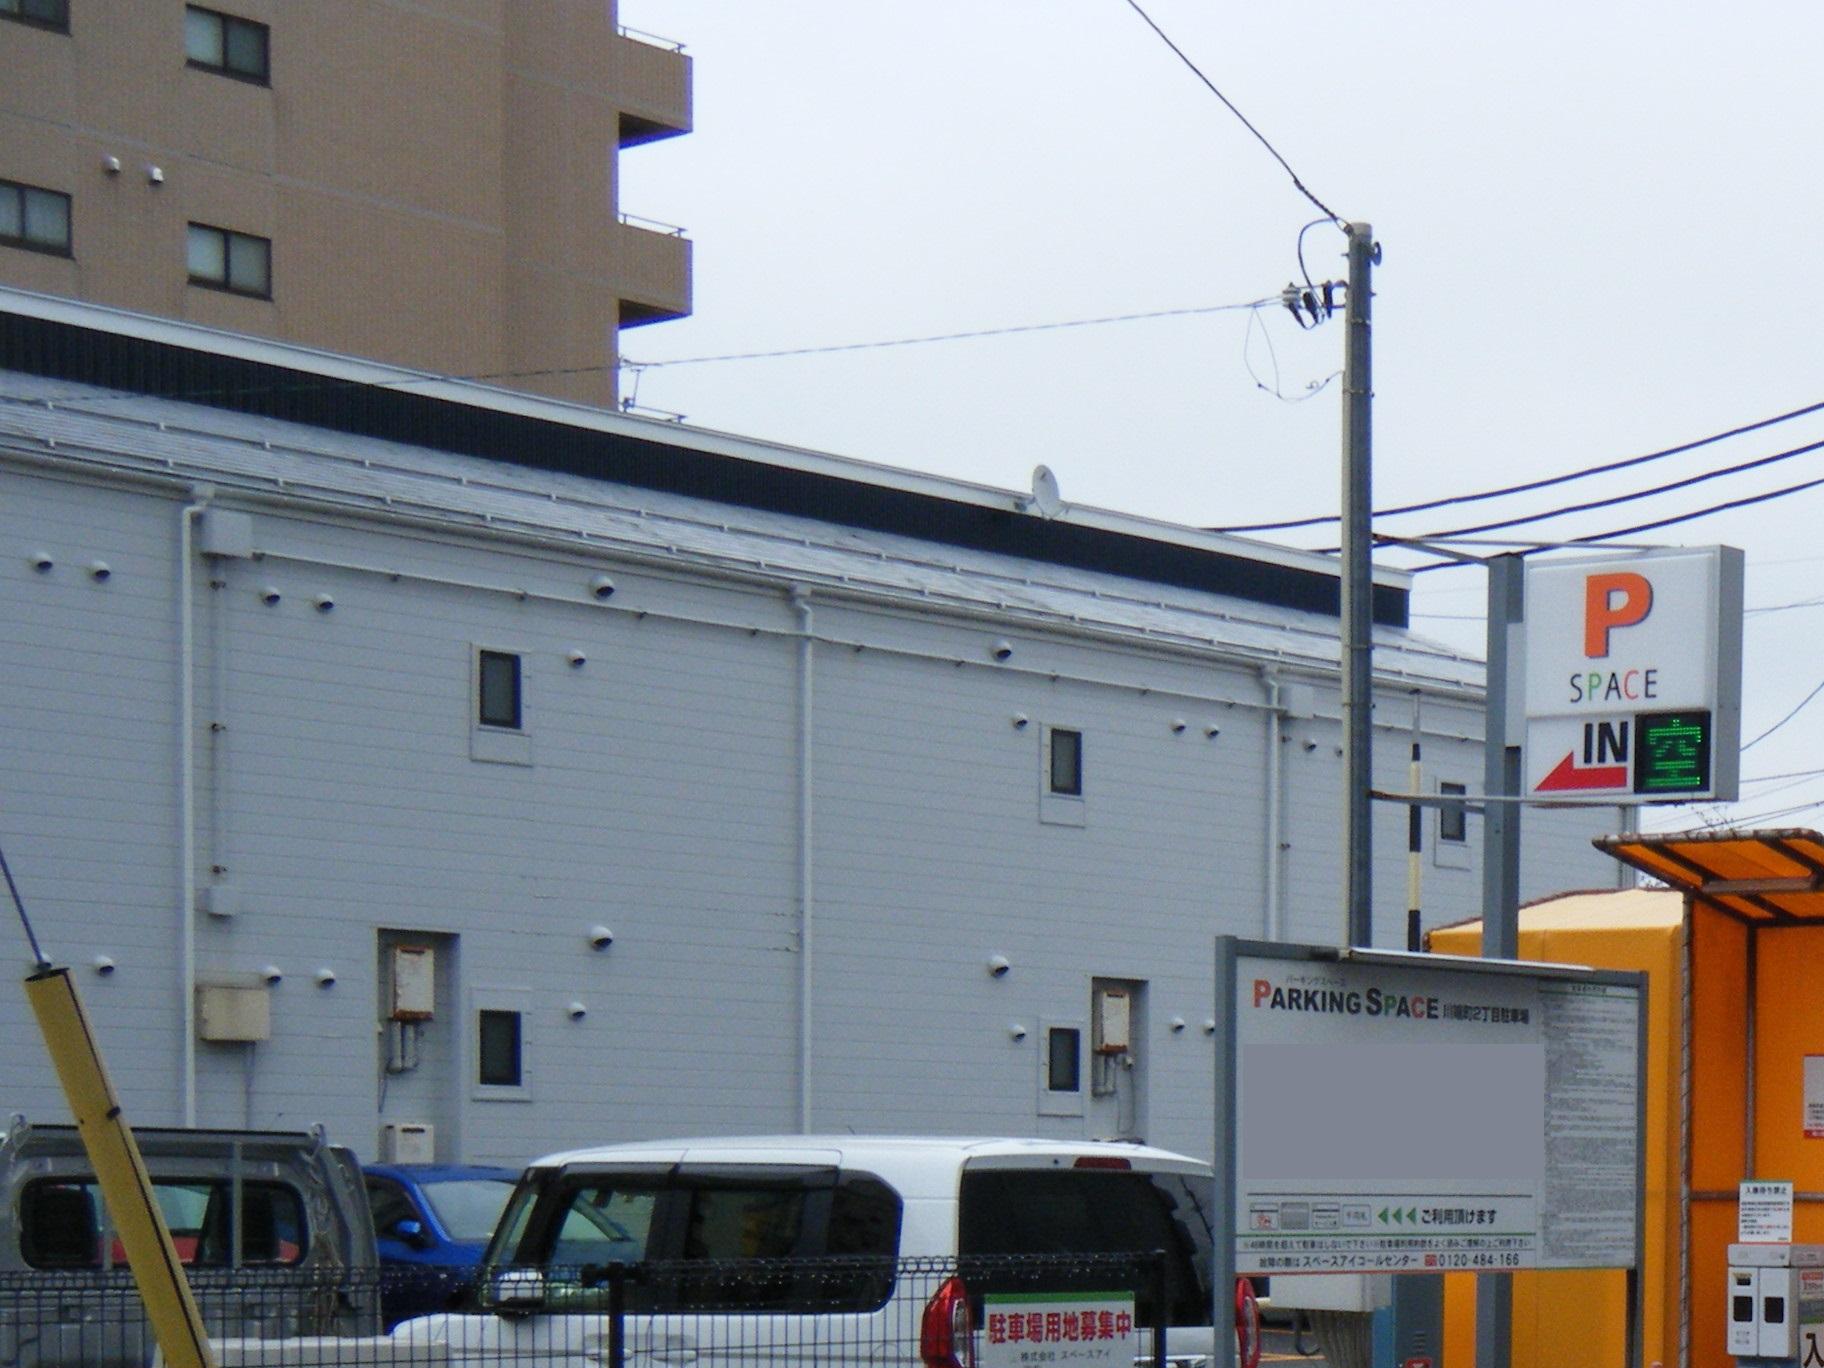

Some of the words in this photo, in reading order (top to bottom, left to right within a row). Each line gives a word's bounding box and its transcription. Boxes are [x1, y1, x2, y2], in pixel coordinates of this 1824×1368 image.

[1584, 572, 1654, 659] P
[1570, 669, 1658, 703] SPACE
[1583, 720, 1629, 765] IN
[1648, 718, 1702, 787] 空
[1252, 979, 1362, 1015] PARKING
[1421, 1208, 1497, 1225] ご利用頂けます
[988, 1309, 1132, 1344] 駐車場用地募集中
